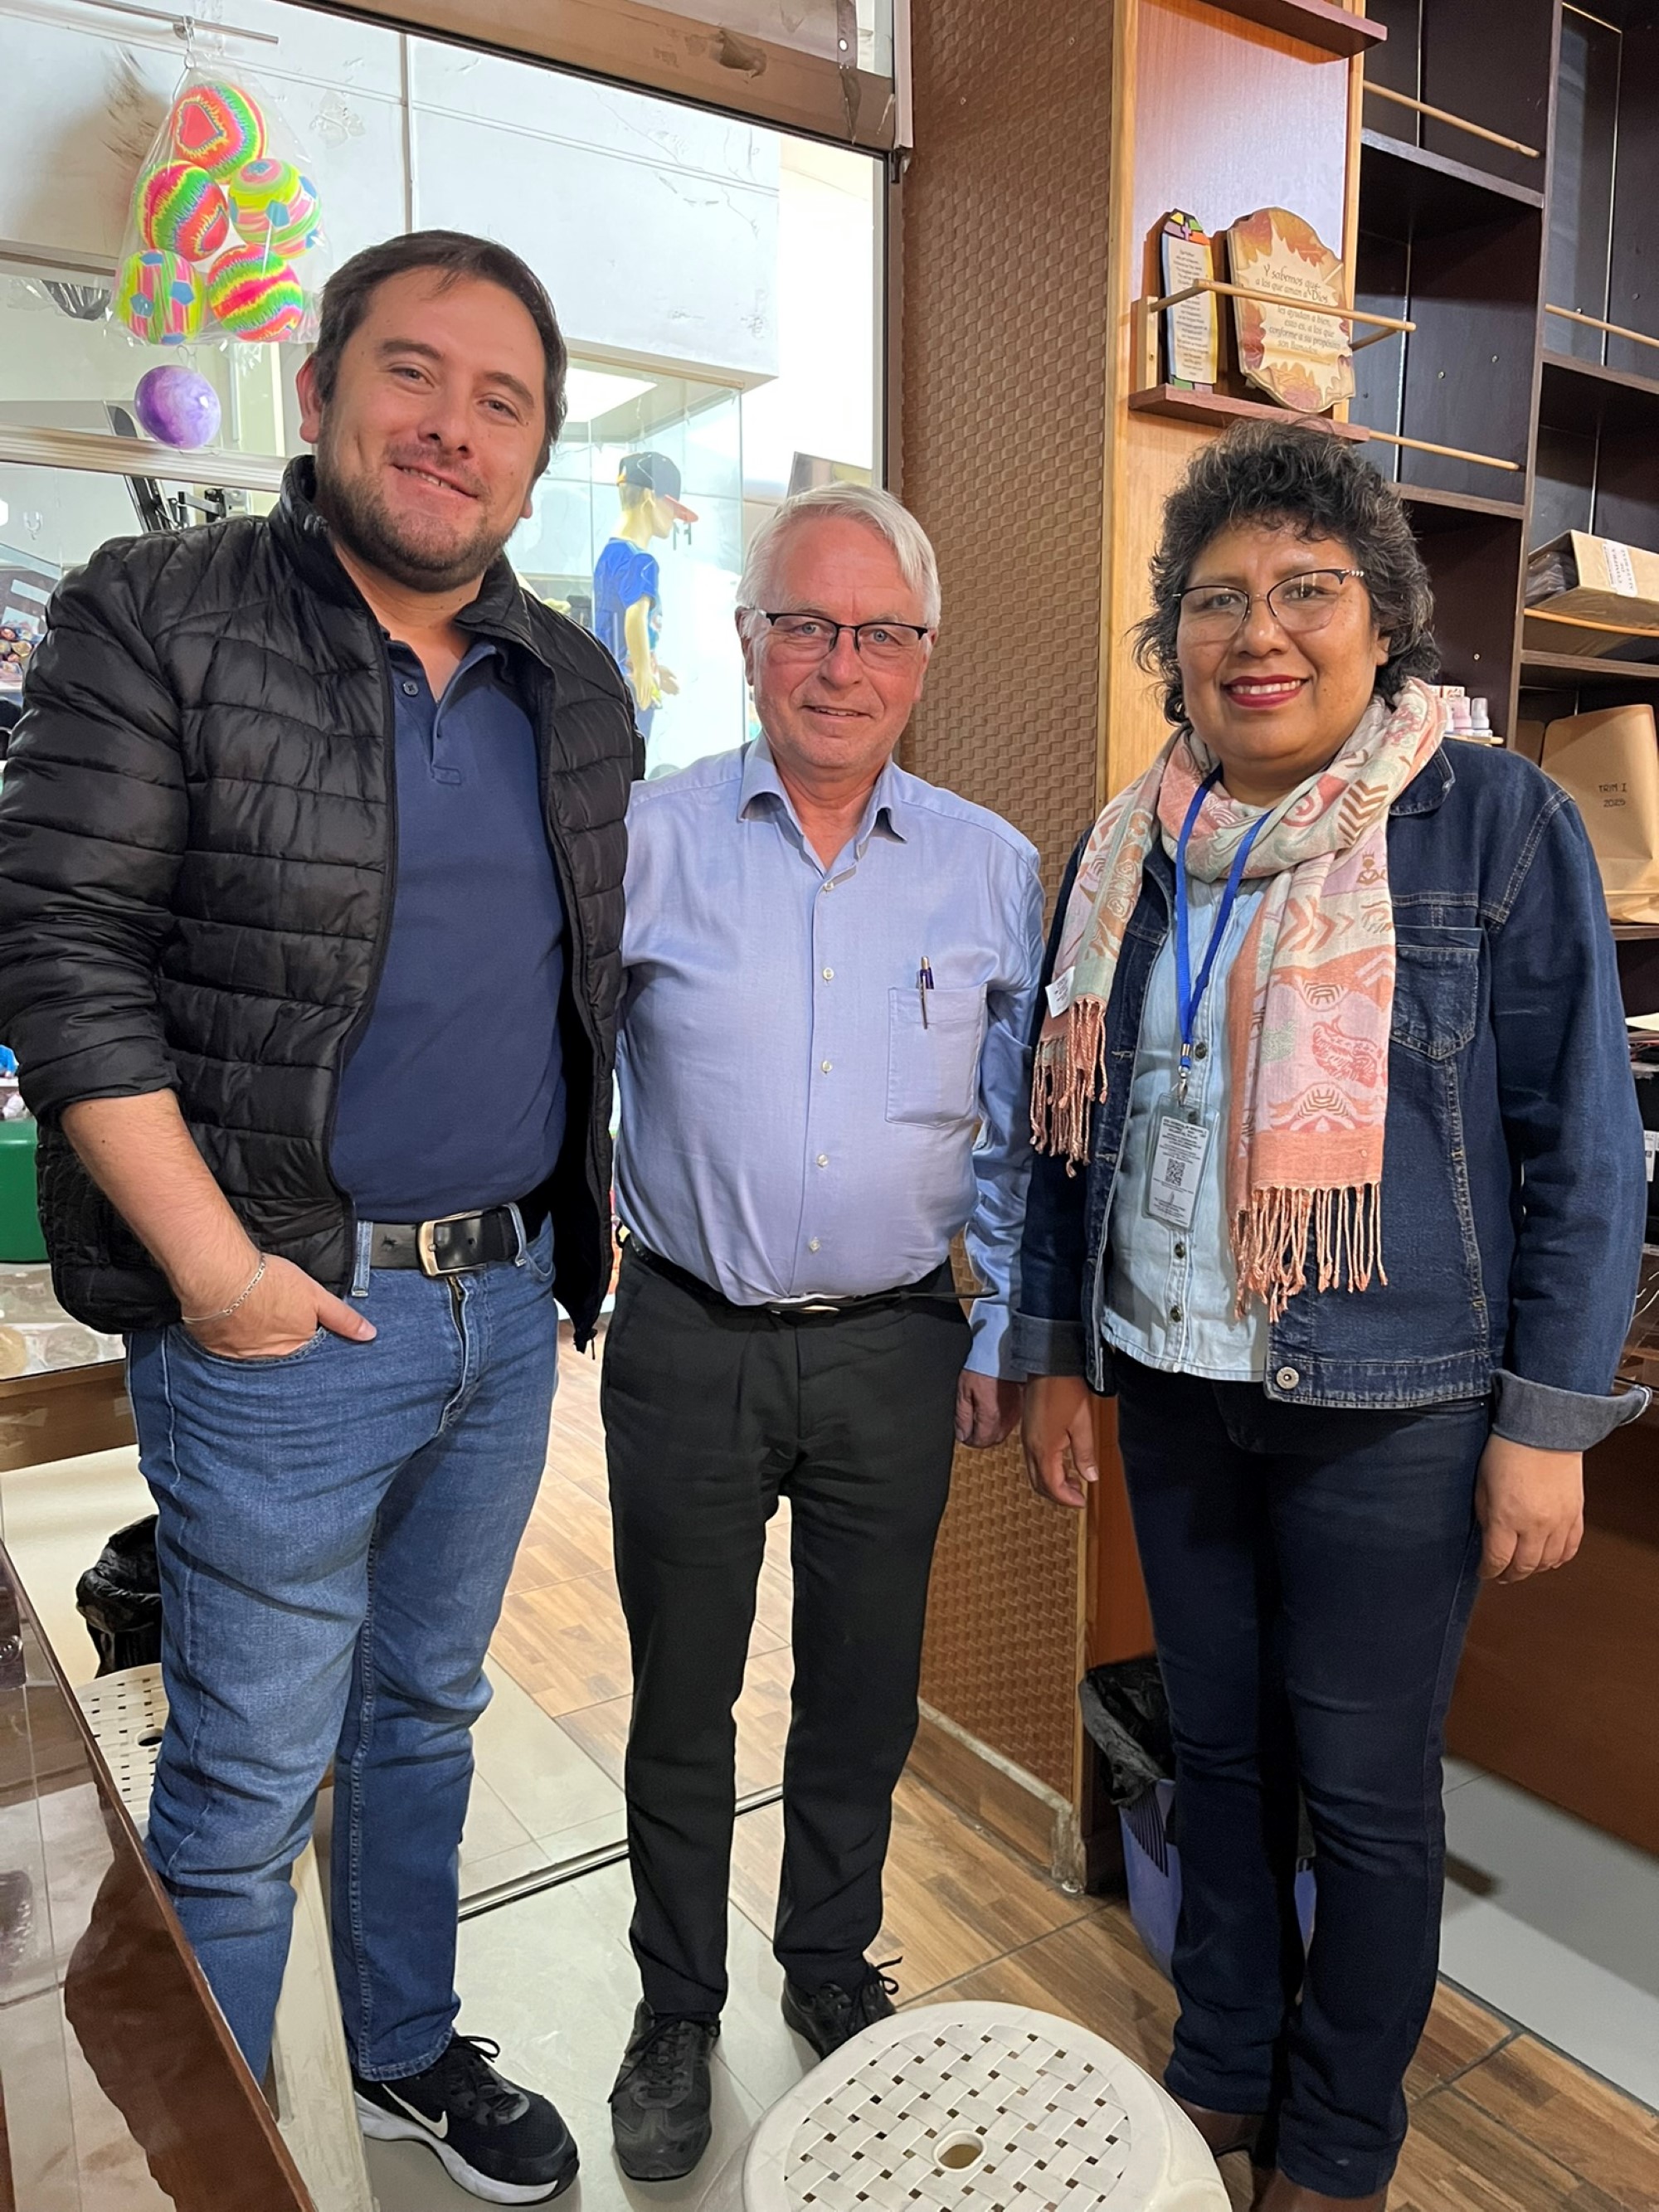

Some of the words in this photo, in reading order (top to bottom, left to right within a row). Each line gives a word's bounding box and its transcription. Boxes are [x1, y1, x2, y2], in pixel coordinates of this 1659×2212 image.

[1262, 264, 1270, 276] Y
[1272, 265, 1303, 286] sabemos
[1305, 280, 1321, 295] que
[1310, 289, 1328, 304] Dios
